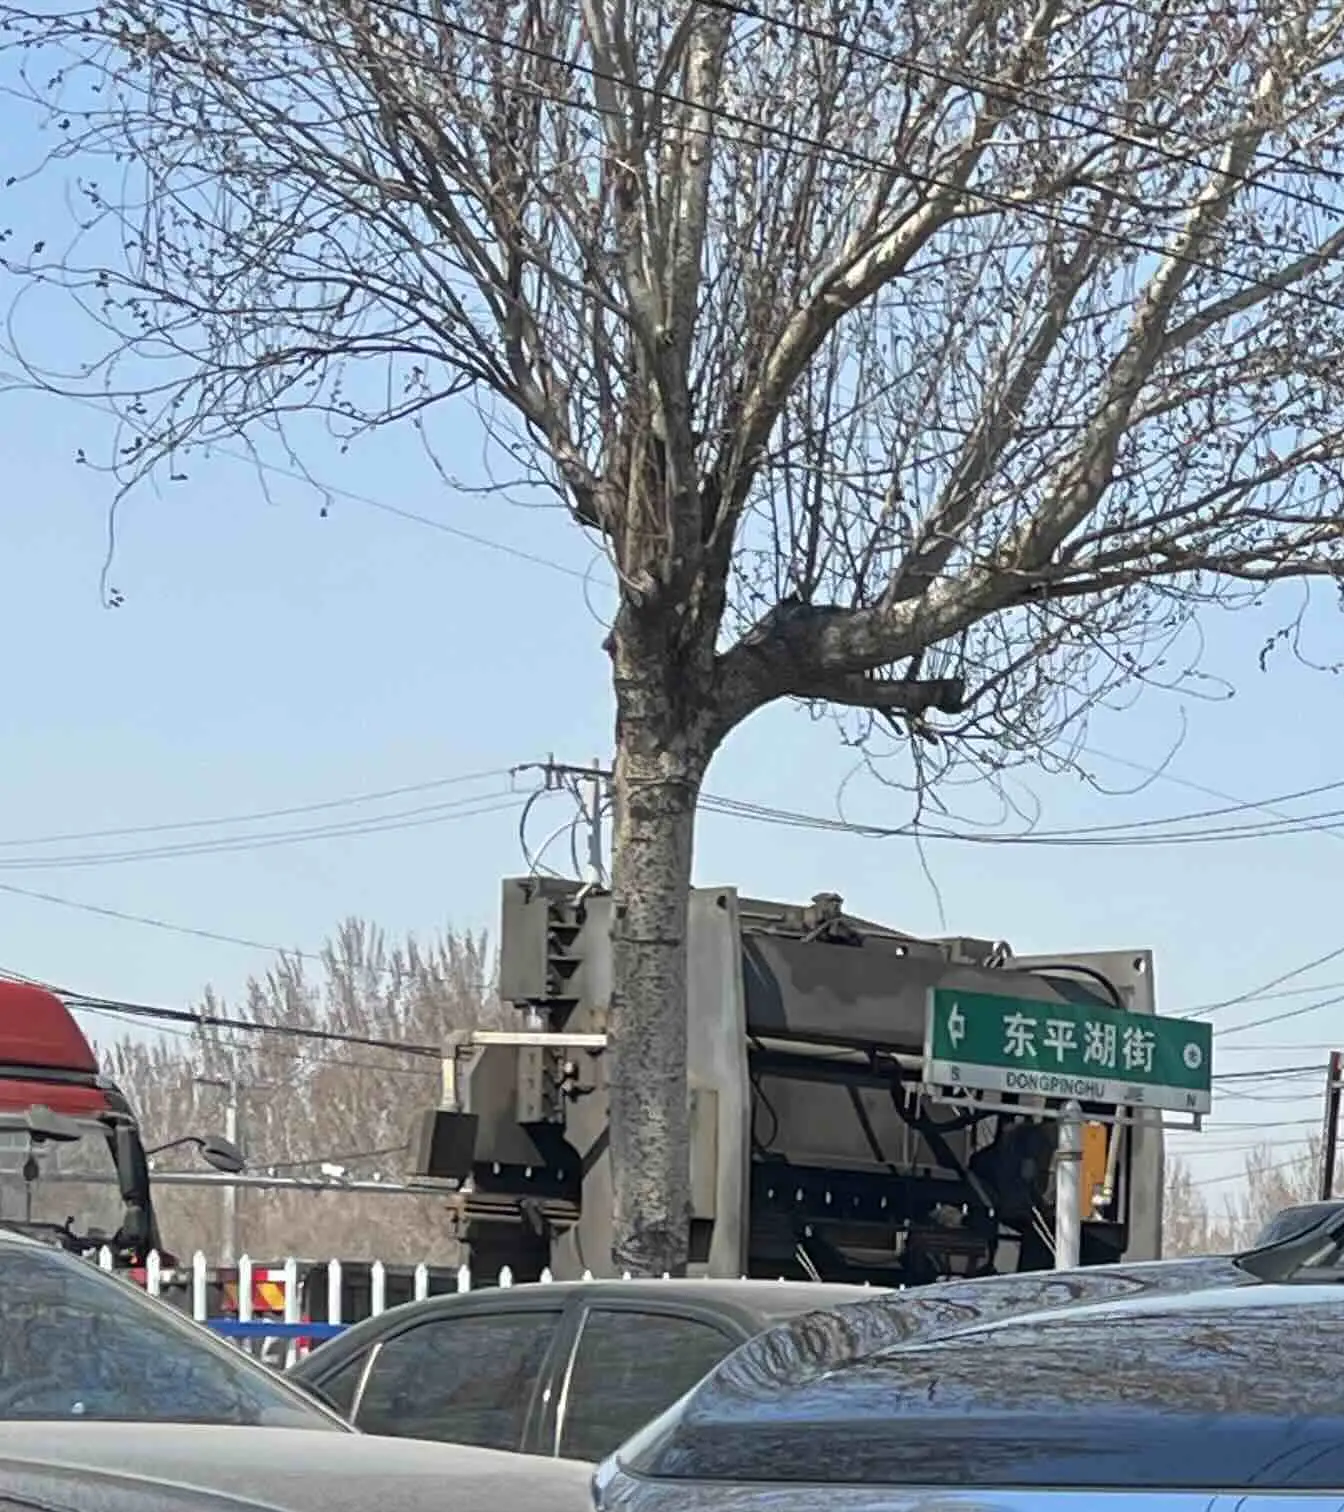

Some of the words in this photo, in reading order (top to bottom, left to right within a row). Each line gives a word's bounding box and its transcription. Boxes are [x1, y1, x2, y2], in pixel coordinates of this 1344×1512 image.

[1003, 1012, 1156, 1073] 东平湖街
[1006, 1072, 1105, 1100] DONGPINGHU
